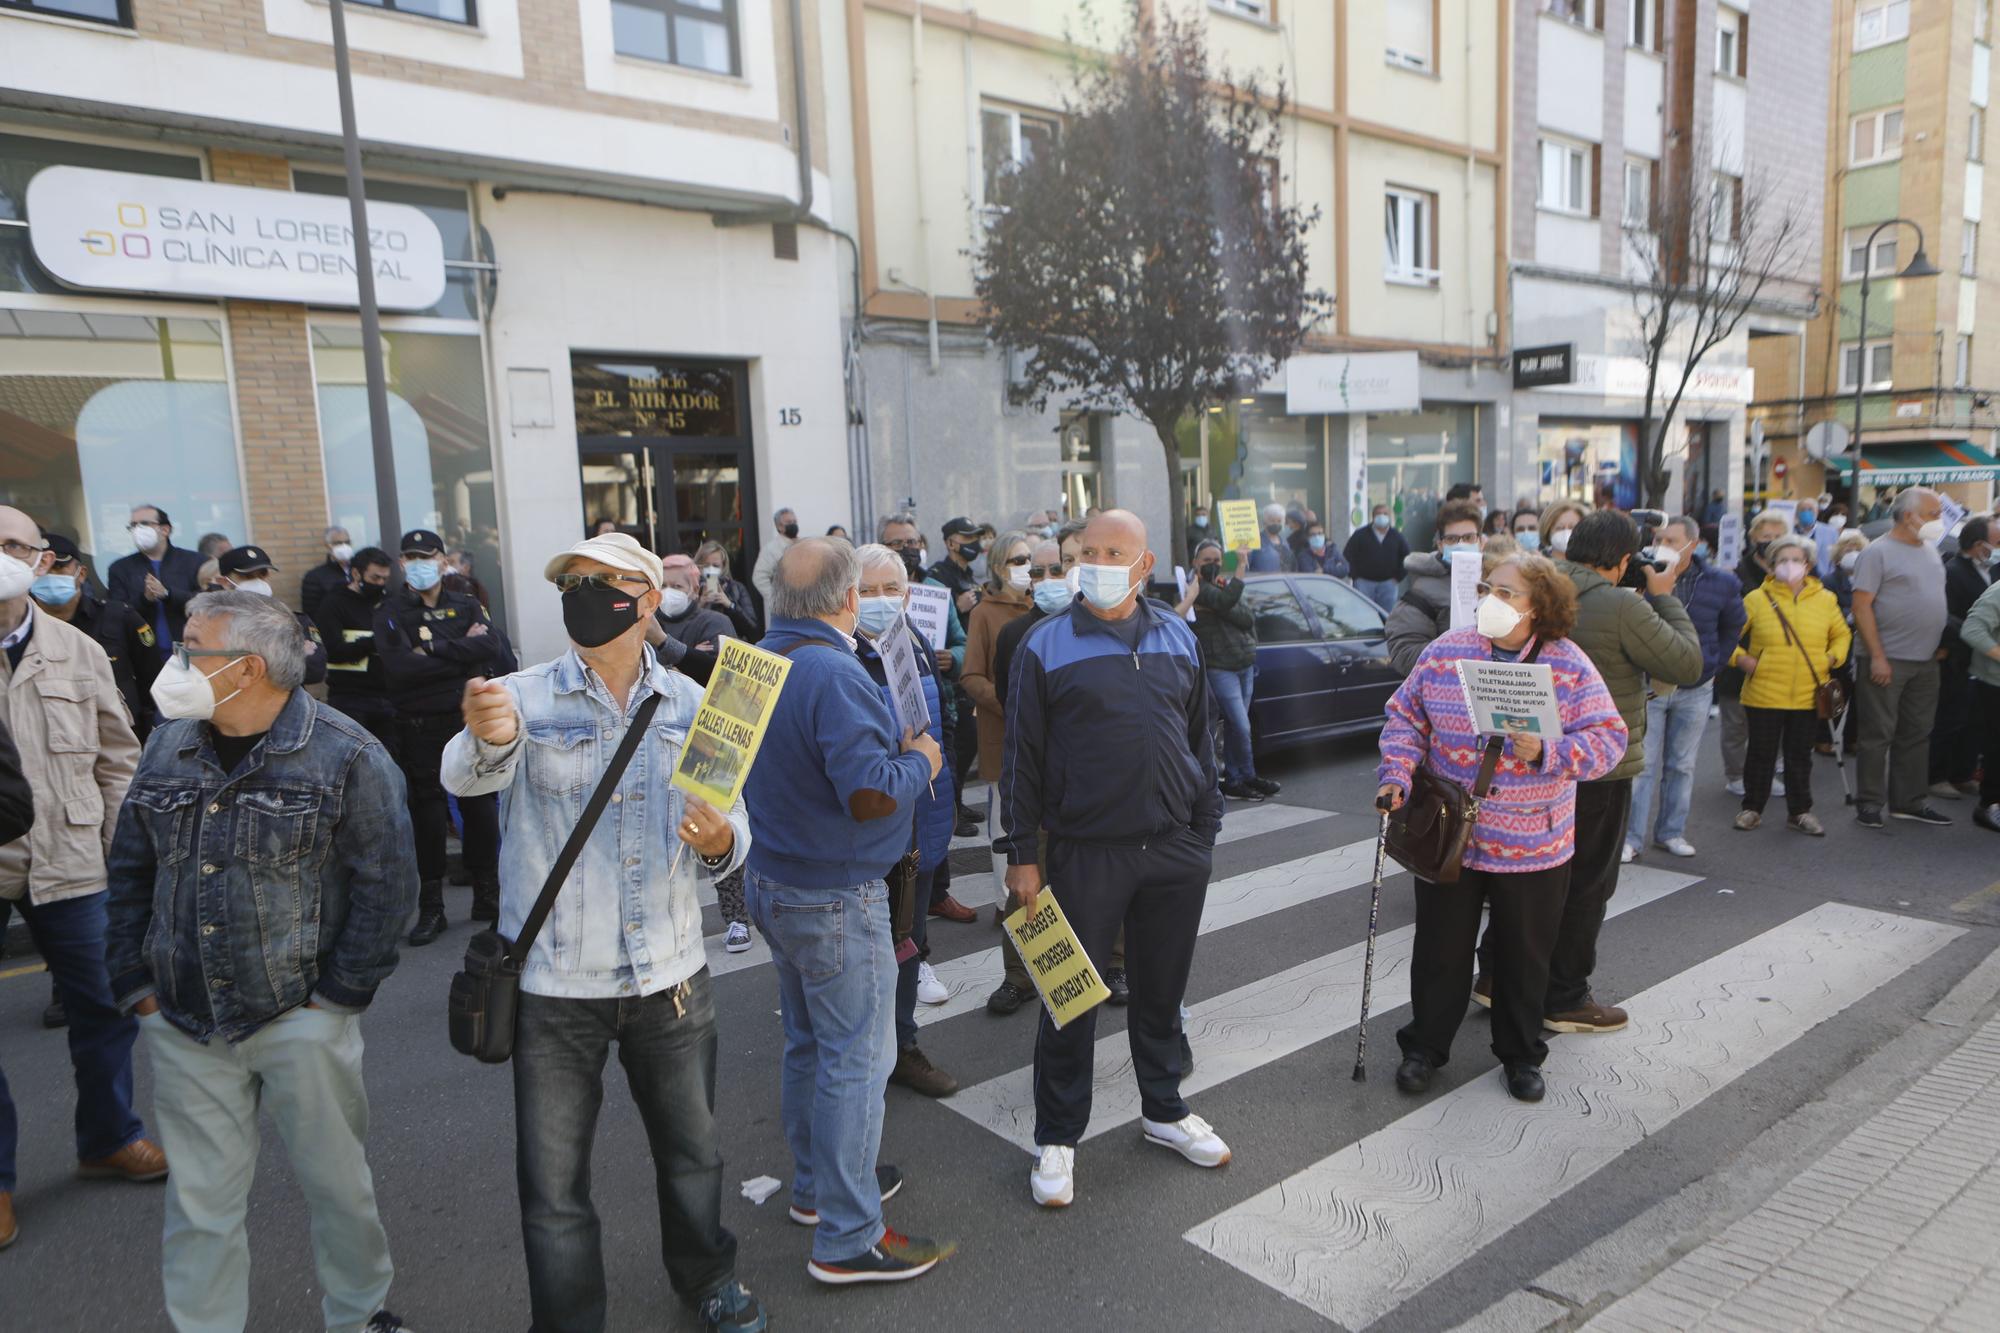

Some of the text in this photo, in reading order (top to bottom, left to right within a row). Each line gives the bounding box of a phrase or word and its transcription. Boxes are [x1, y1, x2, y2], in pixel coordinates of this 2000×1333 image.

[159, 207, 408, 251] SAN LORENZO
[163, 239, 412, 281] CLÍNICA DENAL
[594, 390, 720, 410] EL MIRADOR
[635, 411, 685, 428] Nº 15
[779, 408, 802, 425] 15
[721, 645, 783, 687] SALAS VACÍAS
[1477, 686, 1498, 694] FUERA
[1508, 689, 1548, 697] COBERTURA
[1478, 678, 1537, 688] TELETRABAJANDO
[697, 709, 754, 749] CALLES LLENAS
[1015, 904, 1058, 945] ES ESENCIAL
[1032, 937, 1075, 976] PRESENCIAL
[1079, 968, 1096, 989] LA
